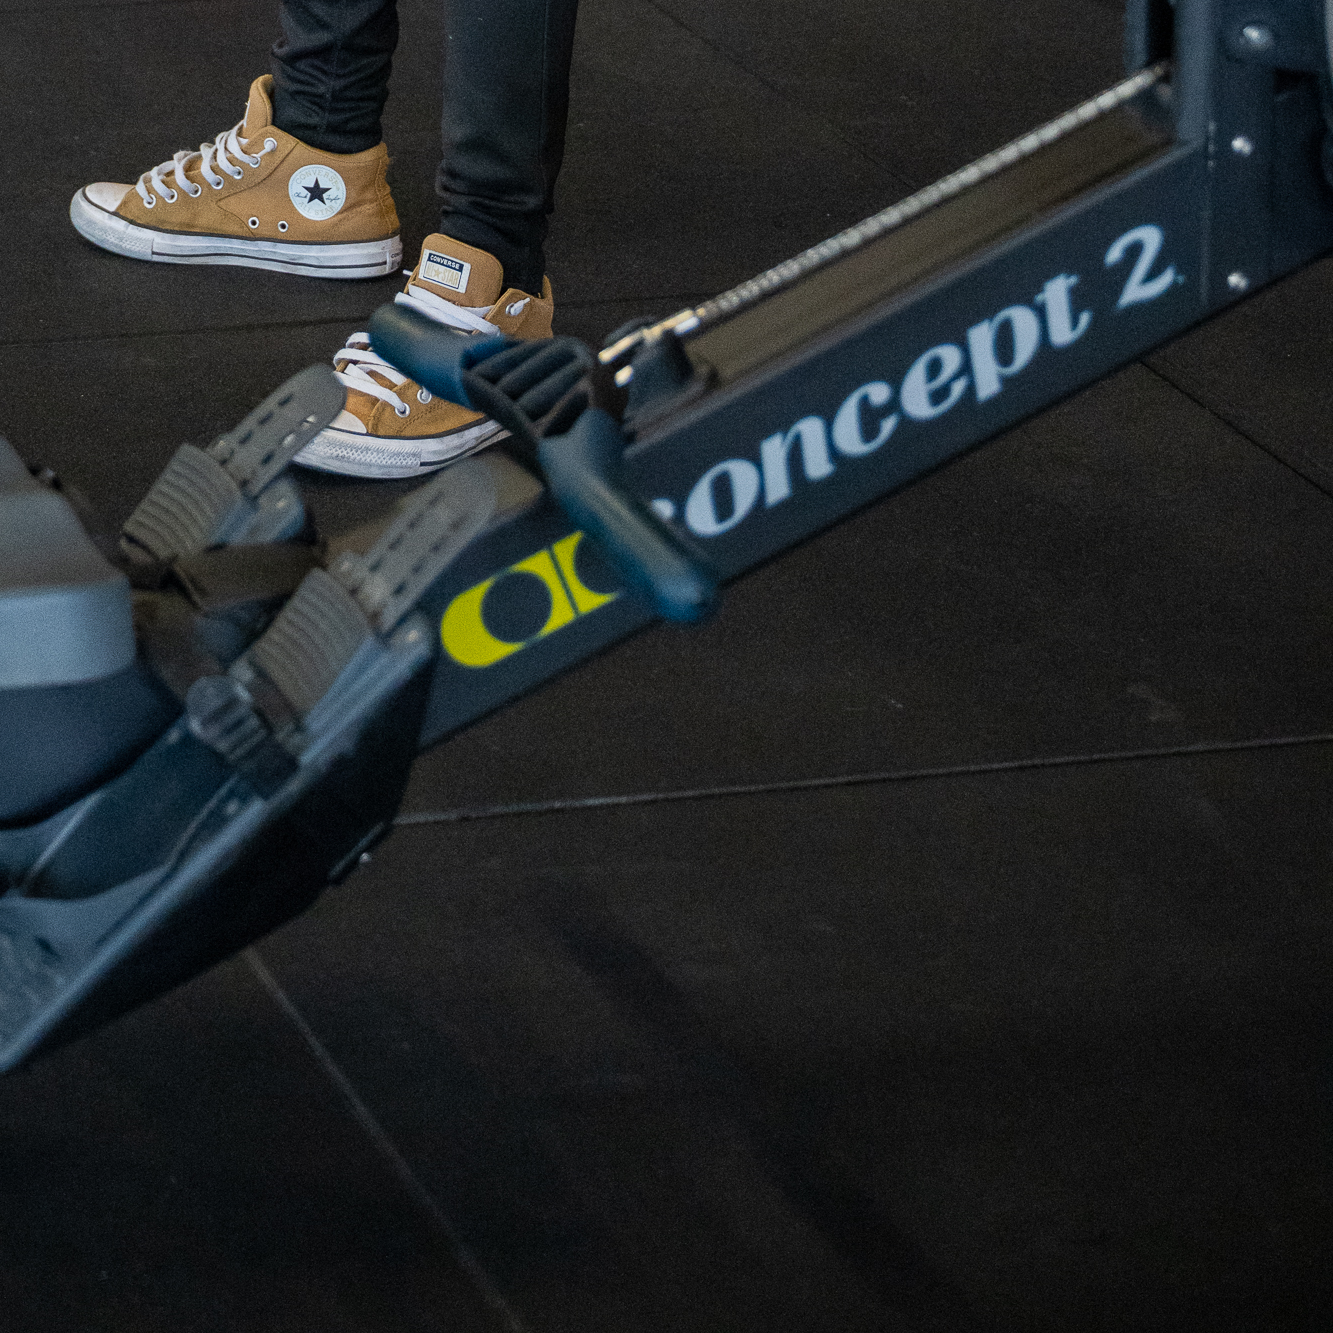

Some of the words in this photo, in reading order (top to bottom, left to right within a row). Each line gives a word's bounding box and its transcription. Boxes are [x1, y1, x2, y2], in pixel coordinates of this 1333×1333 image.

[429, 254, 461, 270] CONVERSE
[651, 271, 1093, 537] oncept
[1103, 222, 1178, 311] 2
